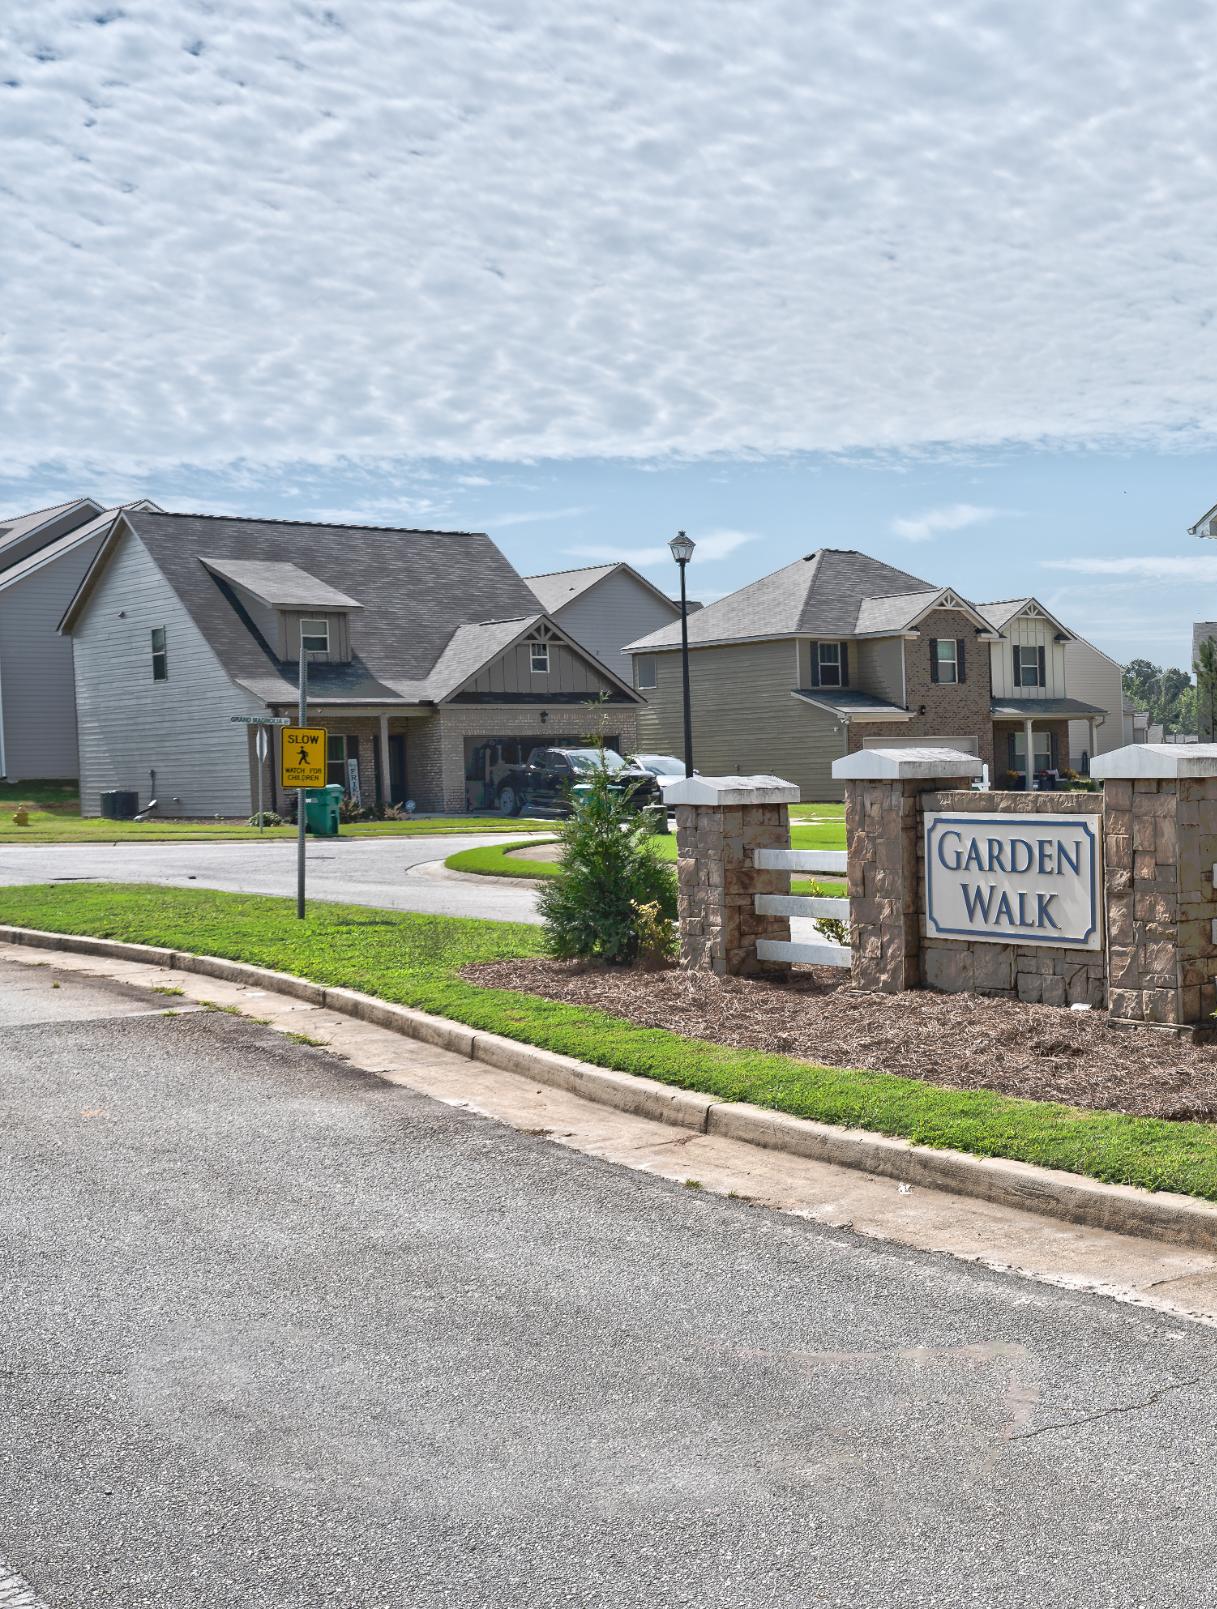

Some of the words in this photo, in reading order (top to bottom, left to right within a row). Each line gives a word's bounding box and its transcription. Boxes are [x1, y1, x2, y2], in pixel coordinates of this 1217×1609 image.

[288, 734, 319, 744] SLOW
[938, 831, 1082, 876] GARDEN
[961, 883, 1062, 930] WALK
